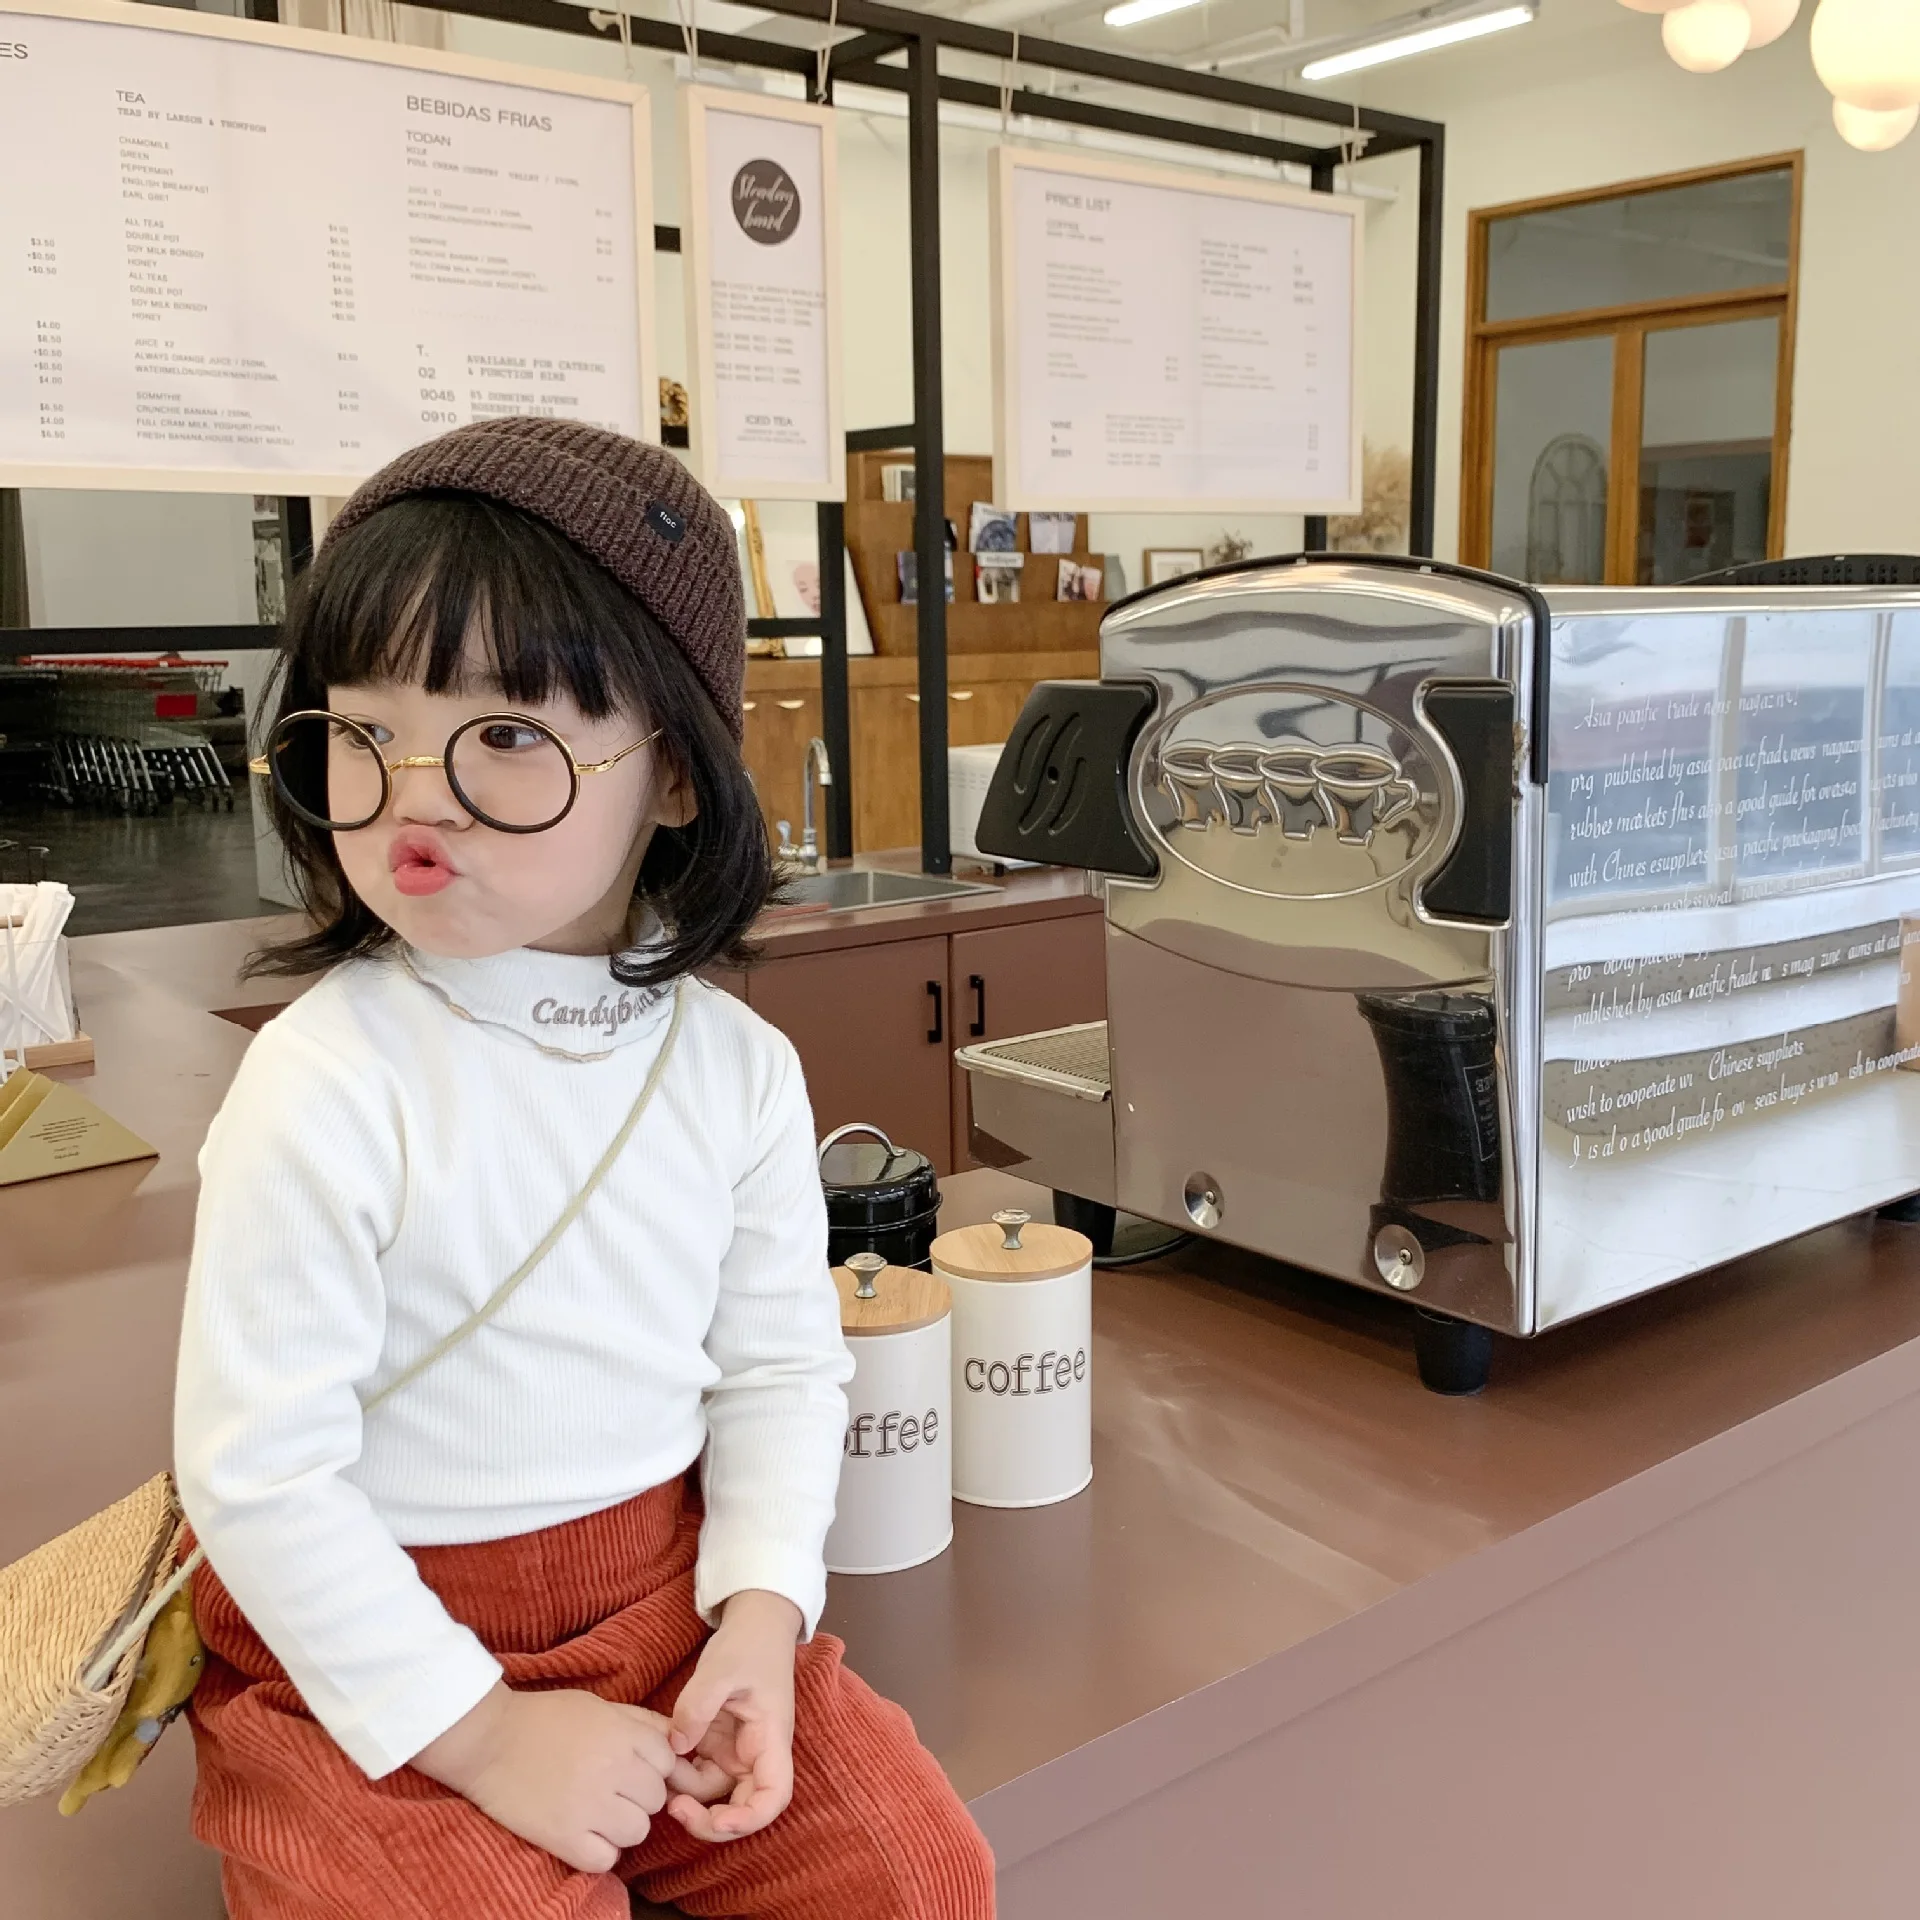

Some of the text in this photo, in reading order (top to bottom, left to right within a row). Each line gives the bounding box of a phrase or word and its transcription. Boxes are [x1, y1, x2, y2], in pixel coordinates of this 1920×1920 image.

[116, 90, 146, 104] TEA
[406, 95, 552, 132] BEBIDAS FRIAS
[418, 367, 436, 380] 02
[467, 354, 526, 368] AVAILABLE
[421, 410, 457, 424] 0910
[1604, 747, 1666, 795] published
[1667, 747, 1684, 785] by
[1686, 759, 1712, 776] asia
[1570, 806, 1613, 841] rubber
[1736, 780, 1766, 821] good
[1769, 776, 1798, 816] guide
[1569, 853, 1598, 888] with
[1638, 982, 1653, 1018] by
[1657, 989, 1682, 1007] asia
[1567, 1085, 1596, 1123] wish
[1600, 1093, 1613, 1113] to
[1616, 1074, 1676, 1110] cooperate
[1708, 1049, 1754, 1081] Chinese
[1631, 1133, 1640, 1148] a
[1644, 1106, 1676, 1151] good
[1677, 1097, 1711, 1141] guide
[964, 1347, 1086, 1396] coffee
[843, 1408, 939, 1458] ffee
